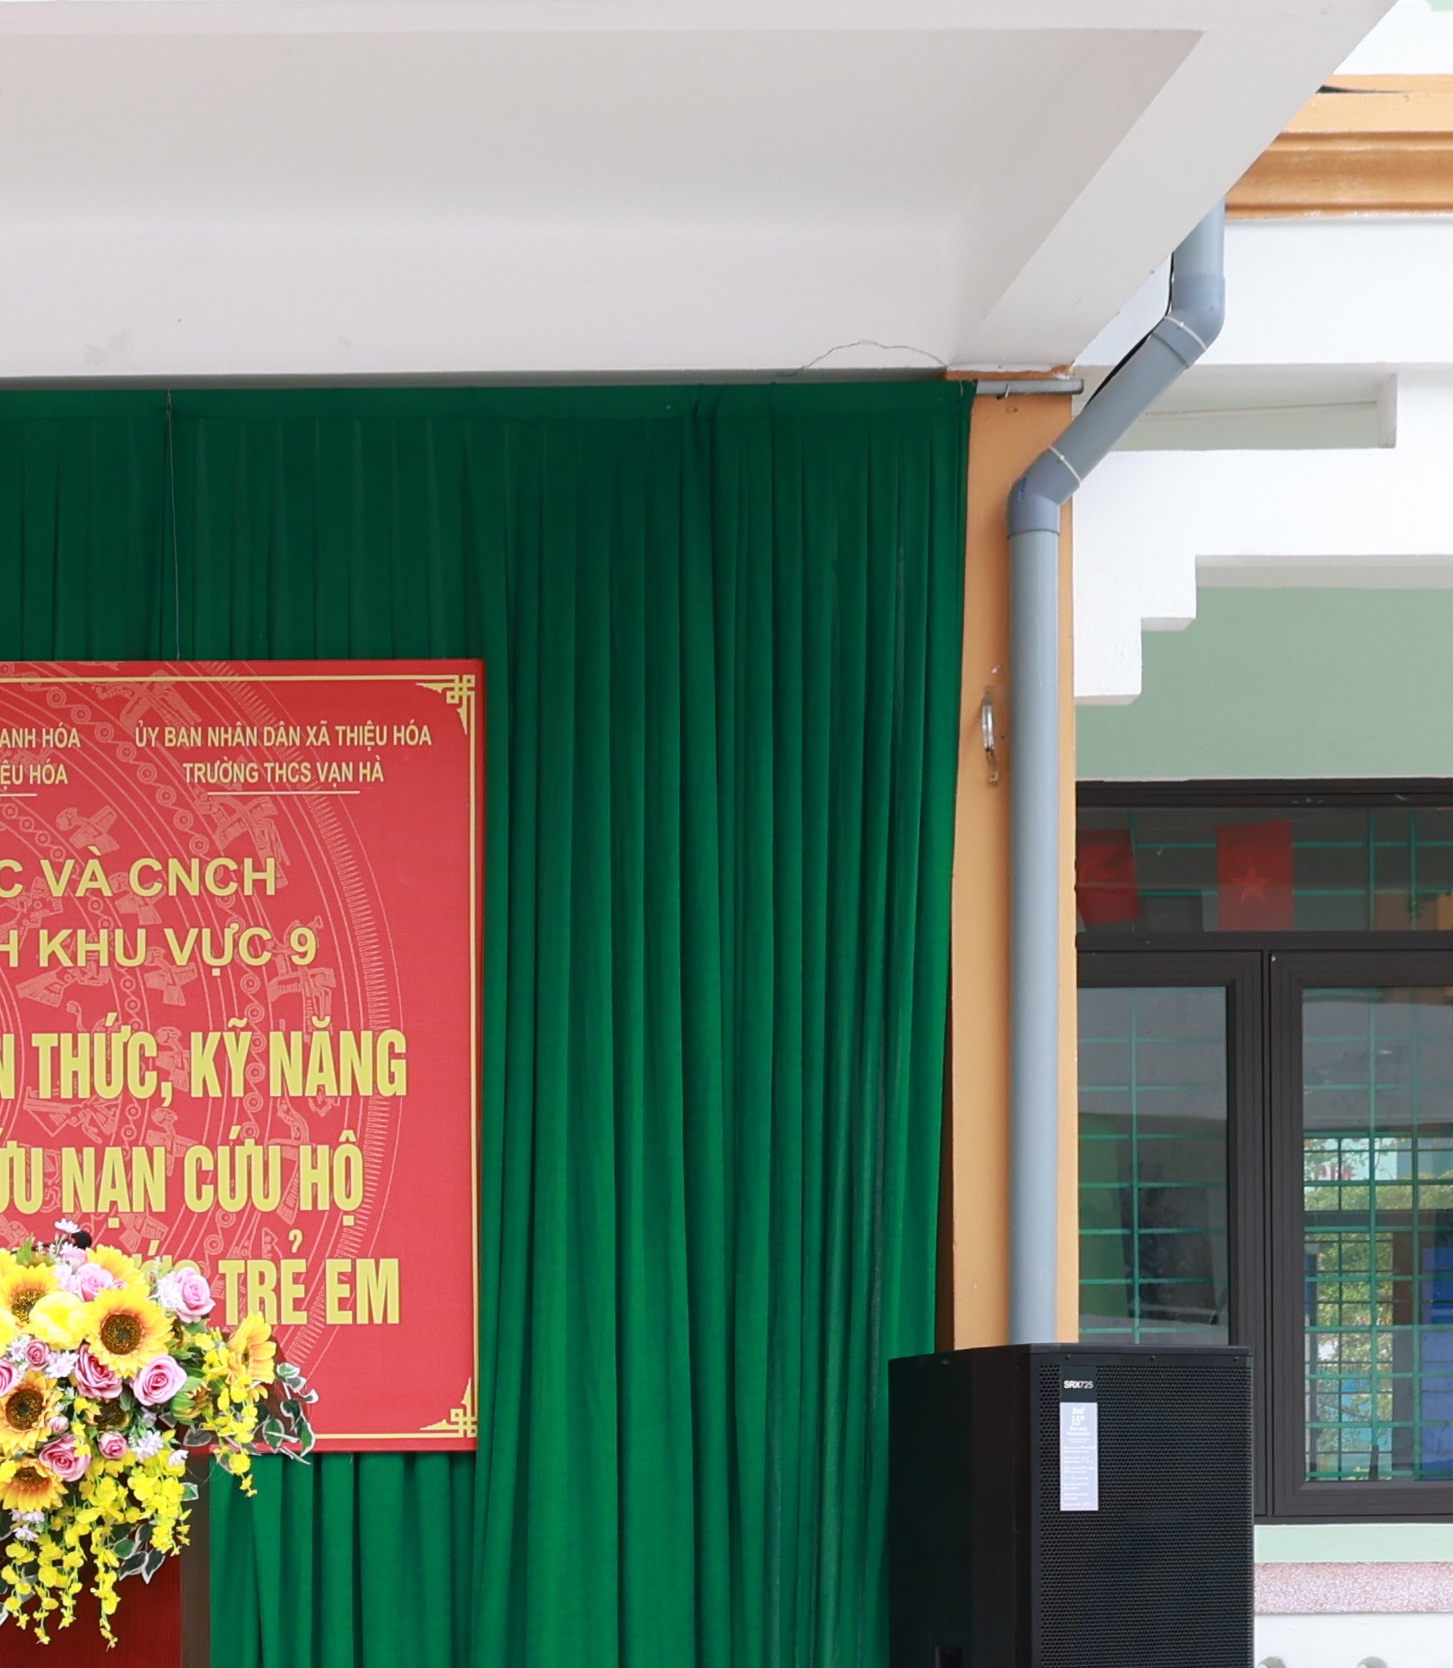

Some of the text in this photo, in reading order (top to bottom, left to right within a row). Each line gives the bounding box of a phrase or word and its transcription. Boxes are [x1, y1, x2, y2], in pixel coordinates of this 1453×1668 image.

[41, 722, 80, 748] HÓA
[135, 719, 432, 751] ỦY BAN NHÂN DÂN XÃ THIỆU HÓA
[29, 759, 68, 785] HÓA
[183, 755, 384, 787] TRƯỜNG THCS VẠN HÀ
[40, 846, 114, 897] VÀ
[128, 857, 277, 897] CNCH
[39, 929, 148, 967] KHU
[165, 923, 273, 975] VỰC
[289, 927, 318, 966] 9
[31, 1012, 174, 1107] THỨC,
[190, 1018, 253, 1098] KỸ
[268, 1016, 408, 1097] NĂNG
[60, 1145, 168, 1228] NẠN
[184, 1125, 284, 1212] CỨU
[298, 1129, 366, 1226] HỘ
[218, 1229, 309, 1326] TRẺ
[324, 1258, 402, 1324] EM
